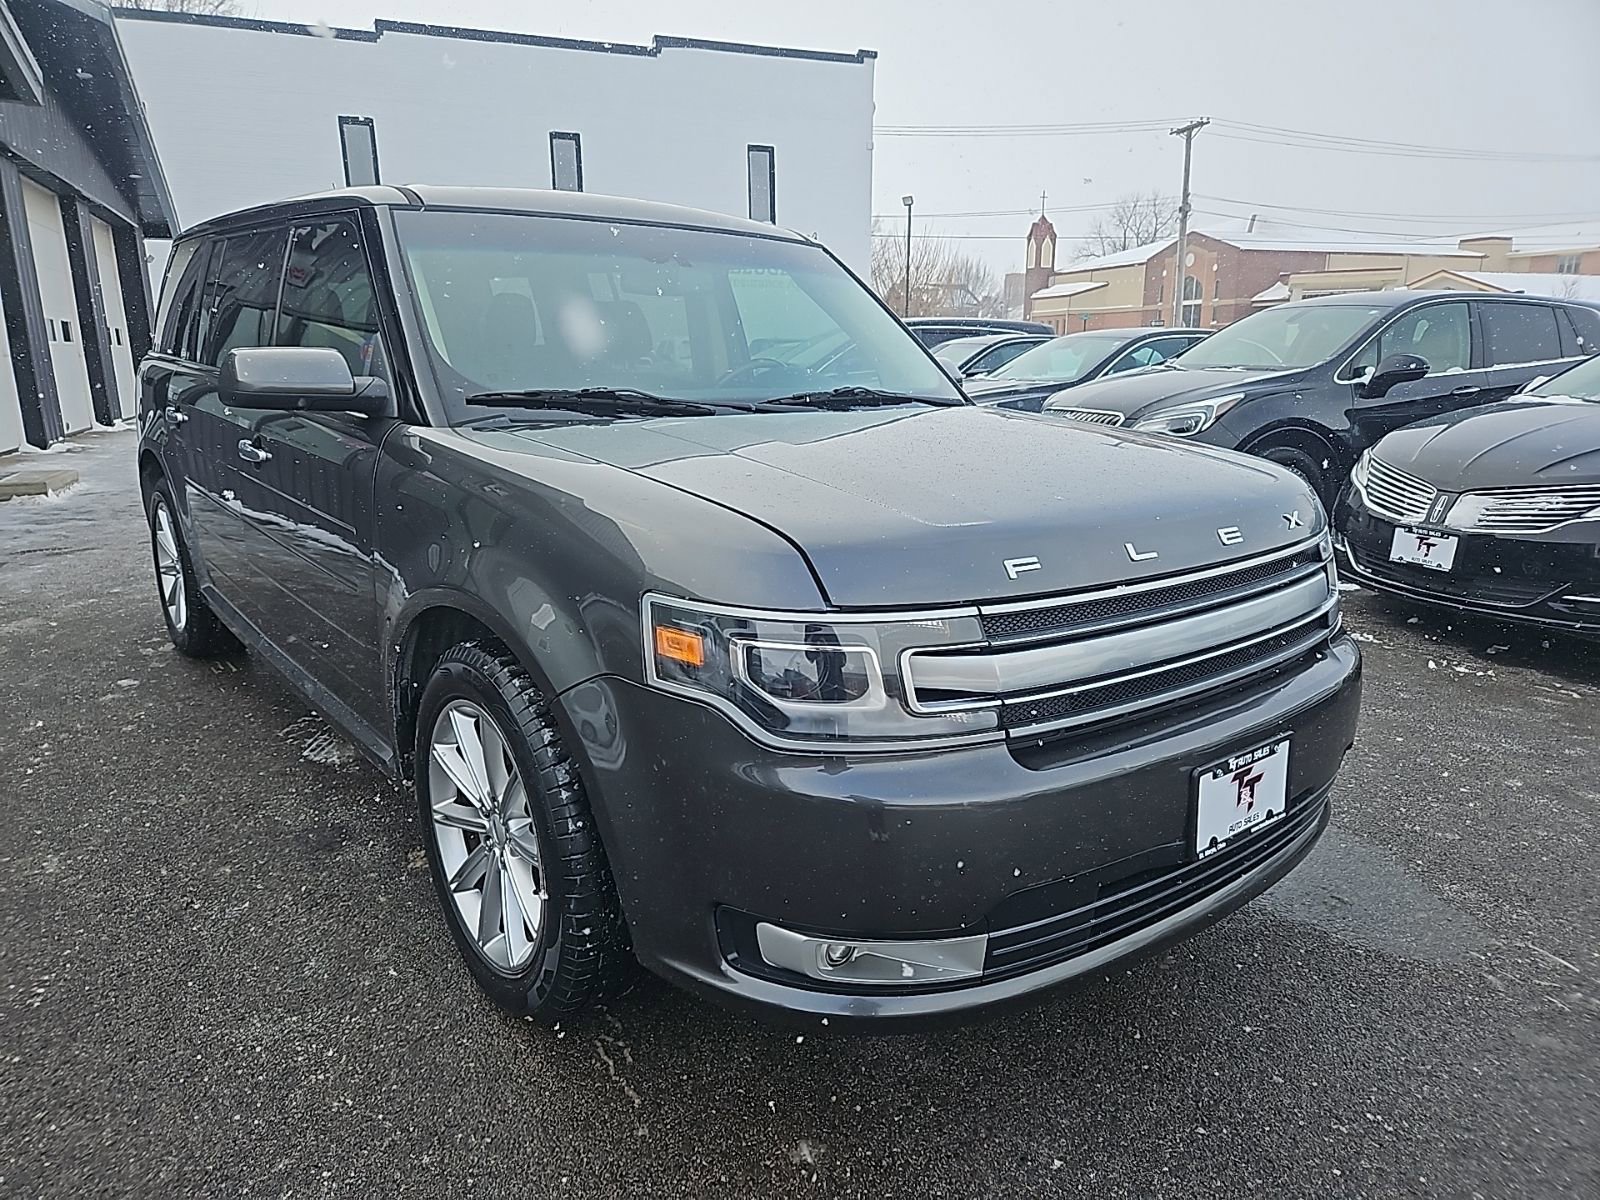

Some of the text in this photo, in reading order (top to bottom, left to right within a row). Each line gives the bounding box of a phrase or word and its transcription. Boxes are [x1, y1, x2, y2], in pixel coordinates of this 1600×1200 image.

[1003, 510, 1303, 580] FLEX
[1237, 753, 1252, 767] AUTO
[1253, 746, 1270, 760] SALES
[1228, 821, 1242, 833] AUTO
[1243, 812, 1260, 826] SALES
